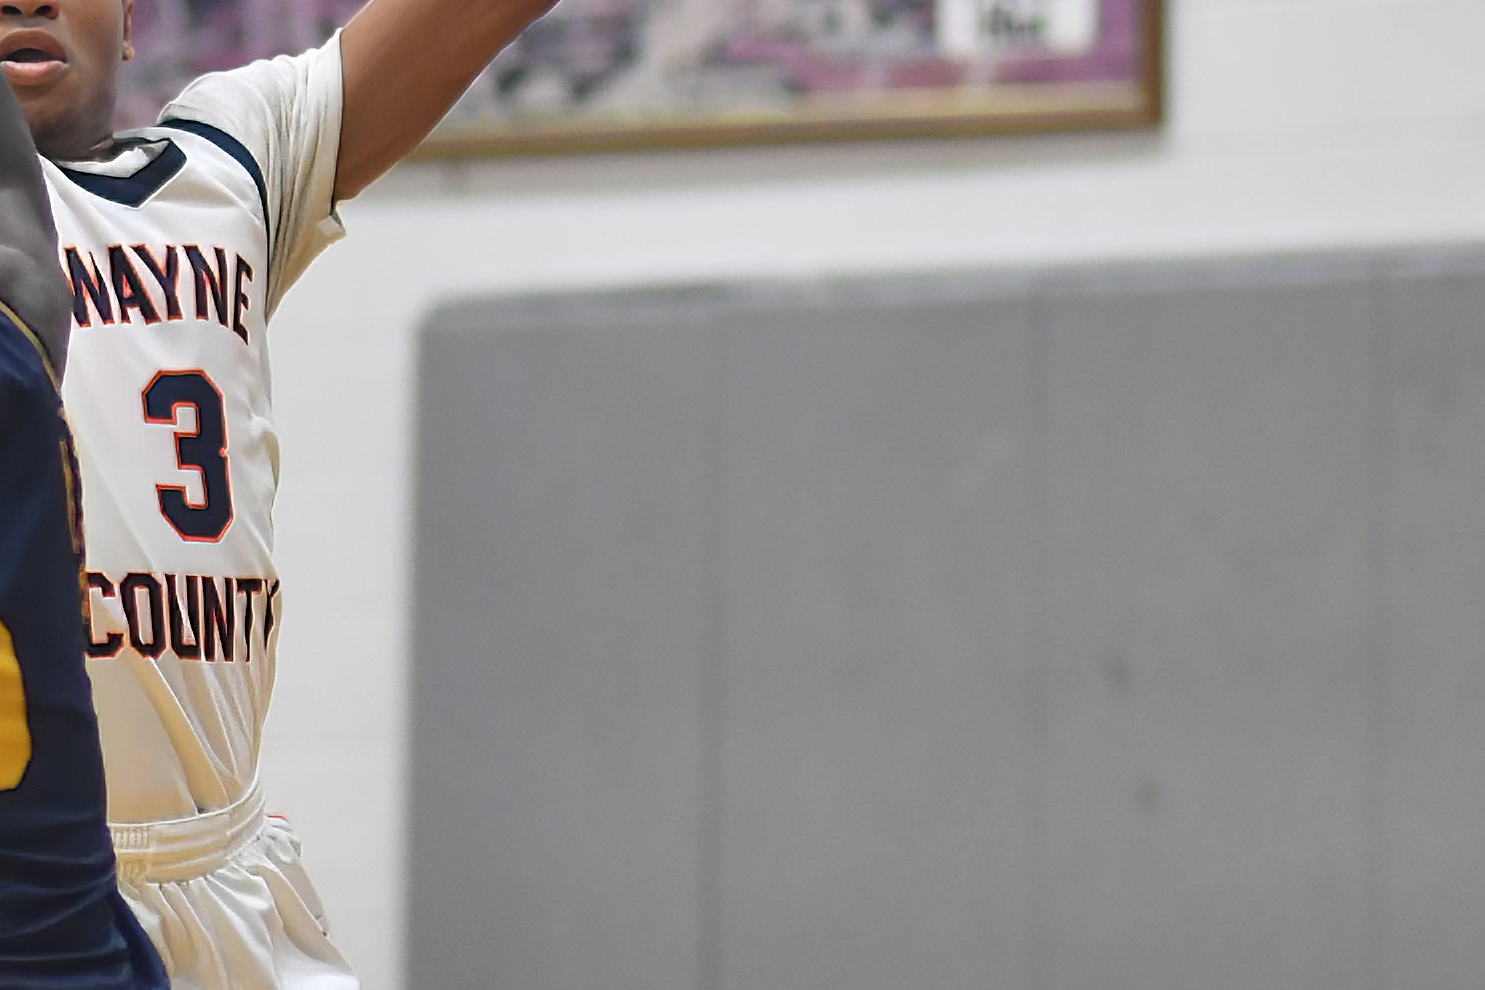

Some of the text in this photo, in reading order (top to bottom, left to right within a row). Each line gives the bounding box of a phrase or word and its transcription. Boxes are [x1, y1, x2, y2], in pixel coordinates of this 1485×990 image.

[64, 244, 253, 346] WAYNE
[141, 369, 234, 543] 3
[85, 571, 280, 662] COUNTY
